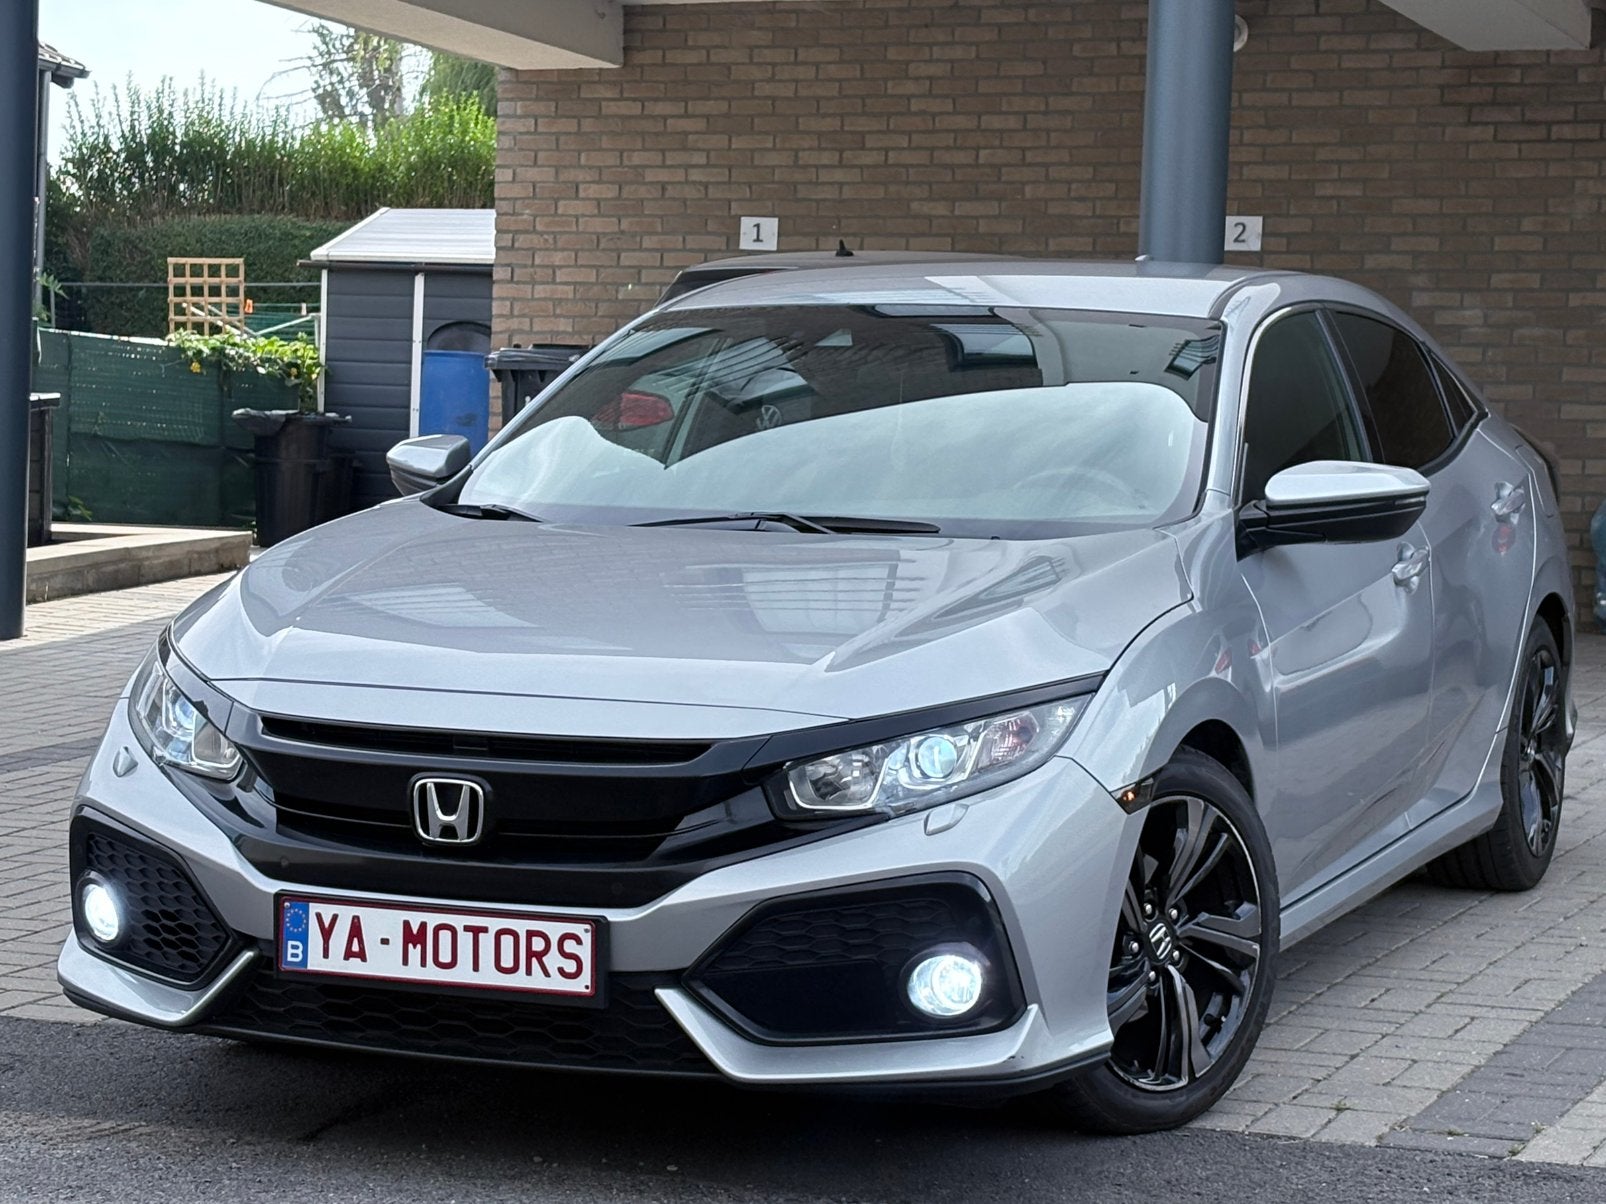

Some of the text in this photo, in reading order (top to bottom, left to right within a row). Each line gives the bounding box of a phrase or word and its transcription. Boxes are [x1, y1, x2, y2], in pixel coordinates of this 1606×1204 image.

[752, 222, 764, 243] 1
[1233, 222, 1246, 243] 2
[287, 940, 303, 962] B
